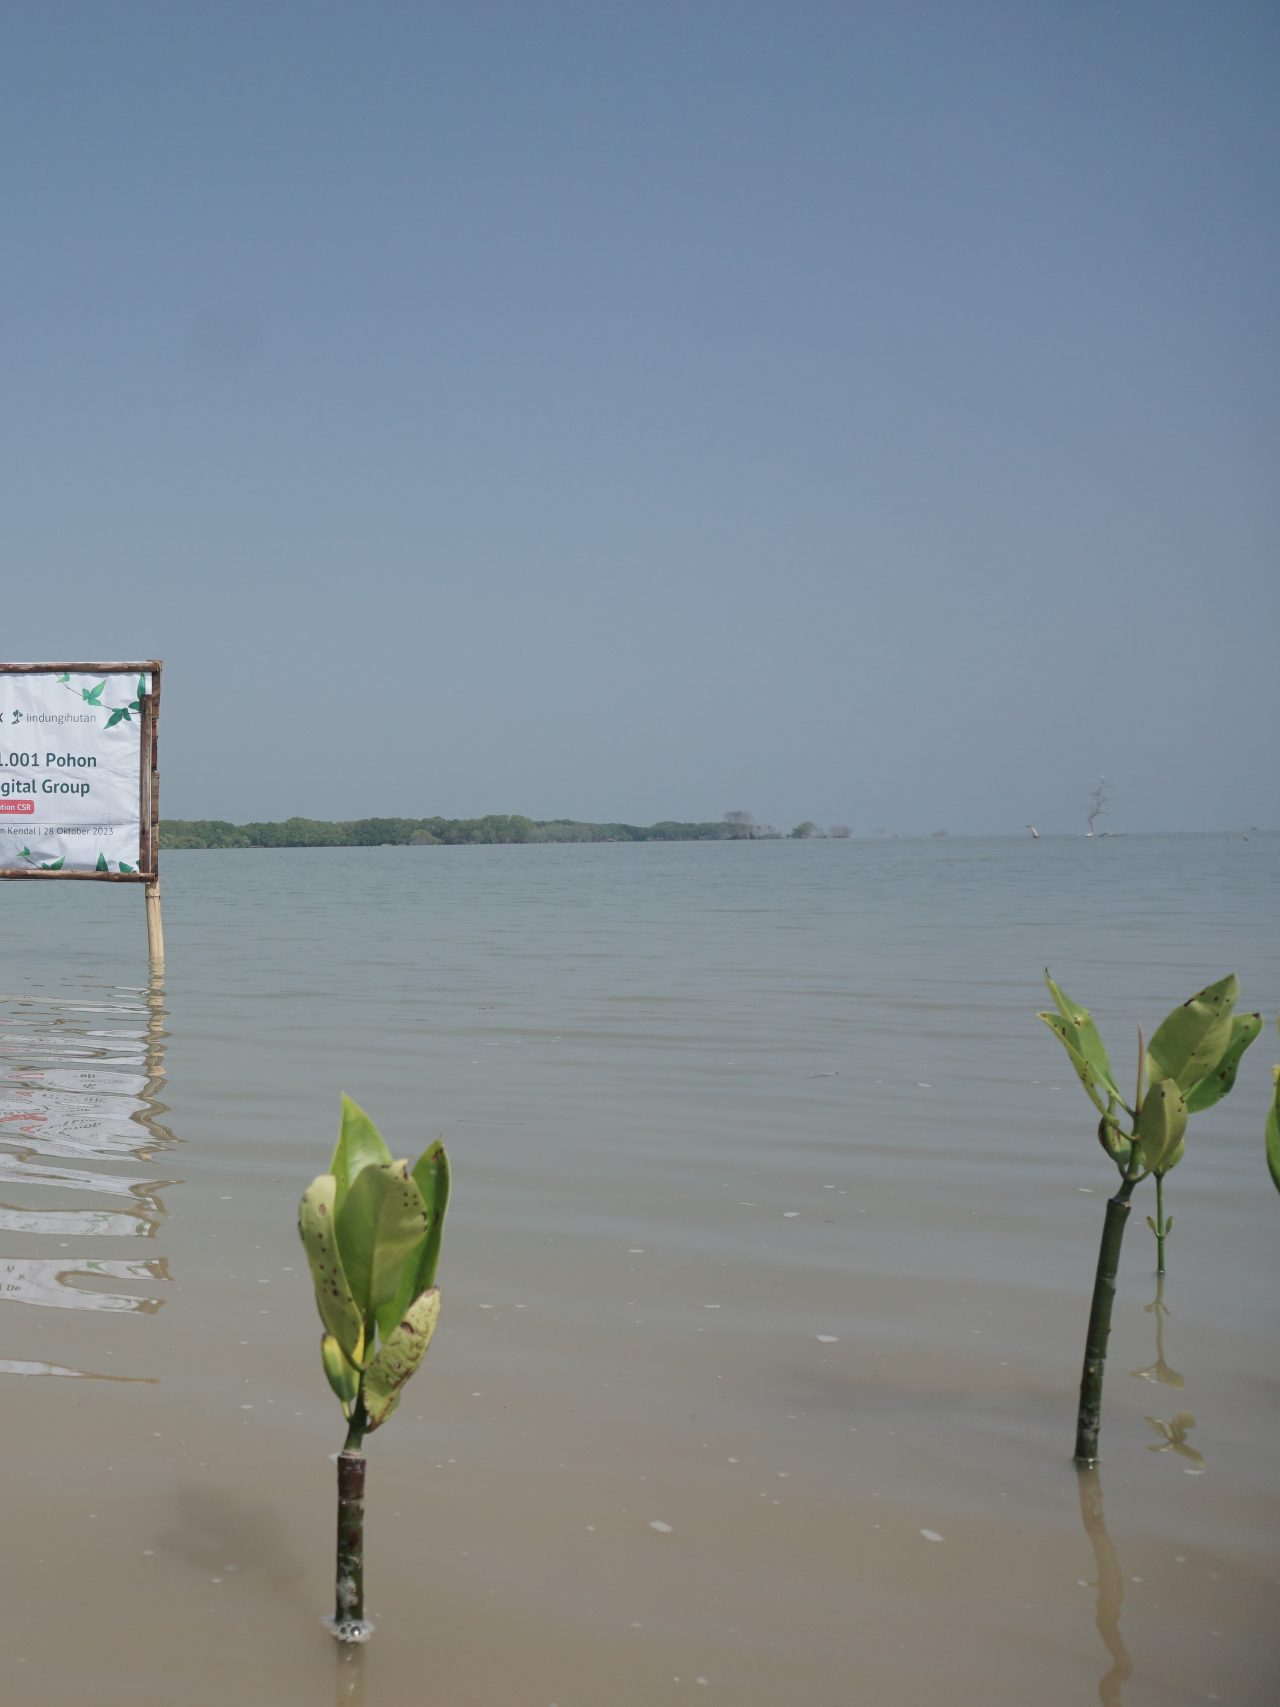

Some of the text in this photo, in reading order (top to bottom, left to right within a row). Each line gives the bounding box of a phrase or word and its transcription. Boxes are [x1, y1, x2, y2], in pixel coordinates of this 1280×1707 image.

[26, 713, 96, 724] lindungihutan
[46, 753, 97, 768] Pohon
[42, 779, 90, 797] Group
[17, 803, 32, 811] CSR
[8, 826, 36, 836] Kendal
[43, 827, 54, 836] 28
[56, 827, 91, 836] Oktober
[93, 827, 114, 836] 2023
